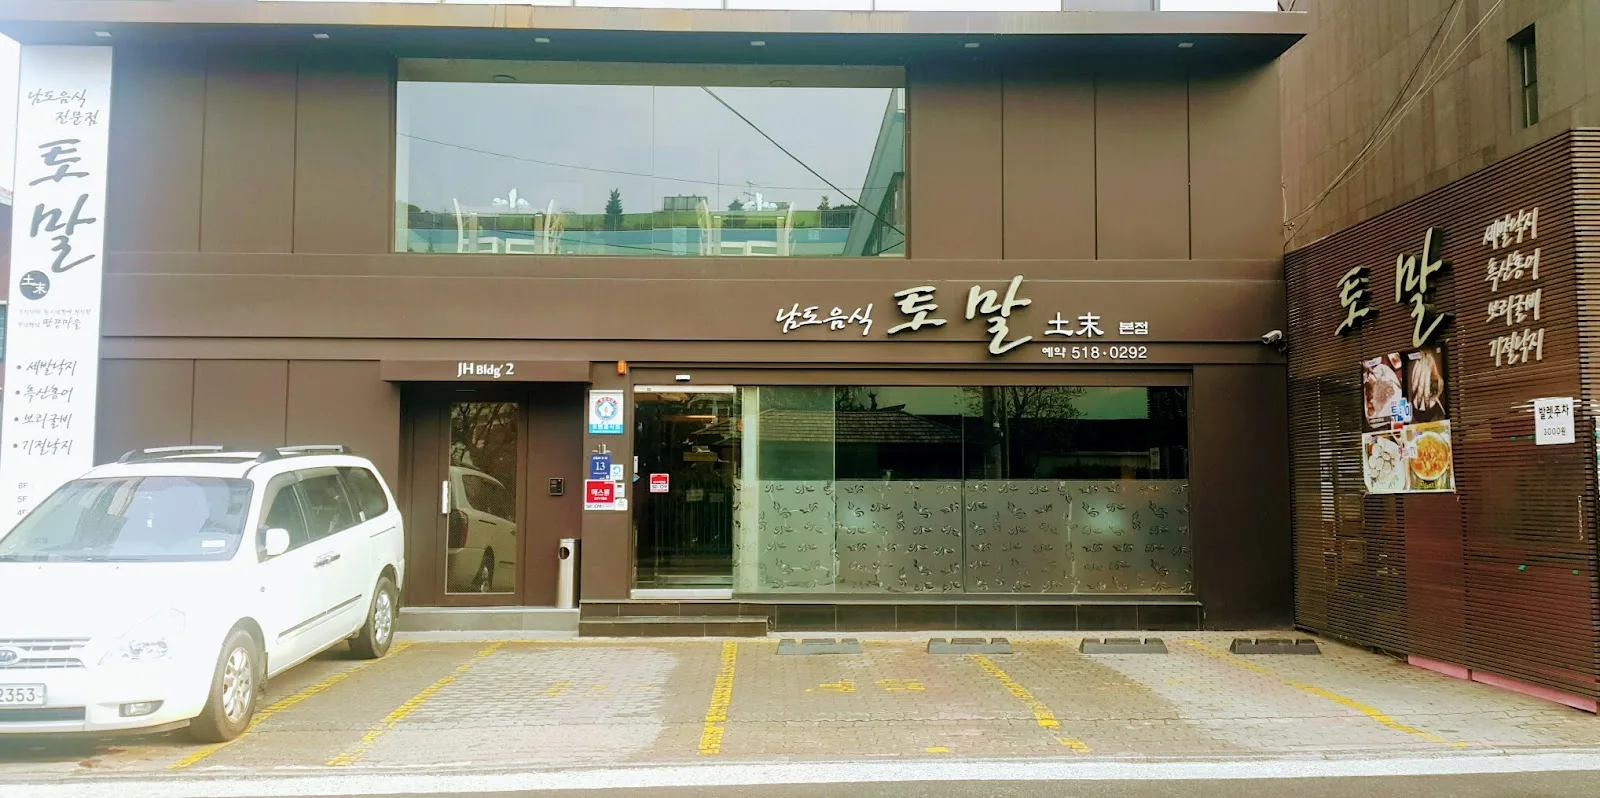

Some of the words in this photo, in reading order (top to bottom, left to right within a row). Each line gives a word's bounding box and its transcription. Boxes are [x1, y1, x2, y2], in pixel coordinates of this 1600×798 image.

[27, 88, 87, 108] 남도음식
[55, 109, 99, 126] 전문점
[1482, 207, 1540, 250] 세발낙지
[1484, 248, 1541, 292] 흑산홍어
[21, 273, 47, 295] 土末
[775, 302, 874, 336] 남도음식
[887, 274, 1034, 355] 토말
[1485, 288, 1542, 326] 보리굴비
[1043, 311, 1105, 338] 土末
[1119, 321, 1148, 335] 본점
[1041, 346, 1067, 358] 예약
[1488, 328, 1545, 367] 기절낙지
[26, 359, 77, 376] 세발낙지
[456, 362, 474, 377] JH
[505, 362, 515, 375] 2
[24, 384, 73, 403] 흑산홍어
[1539, 404, 1569, 420] 발렛주차
[22, 413, 72, 429] 보리굴비
[1543, 427, 1566, 436] 3000원
[22, 438, 73, 455] 기절낙지
[595, 461, 606, 471] 13
